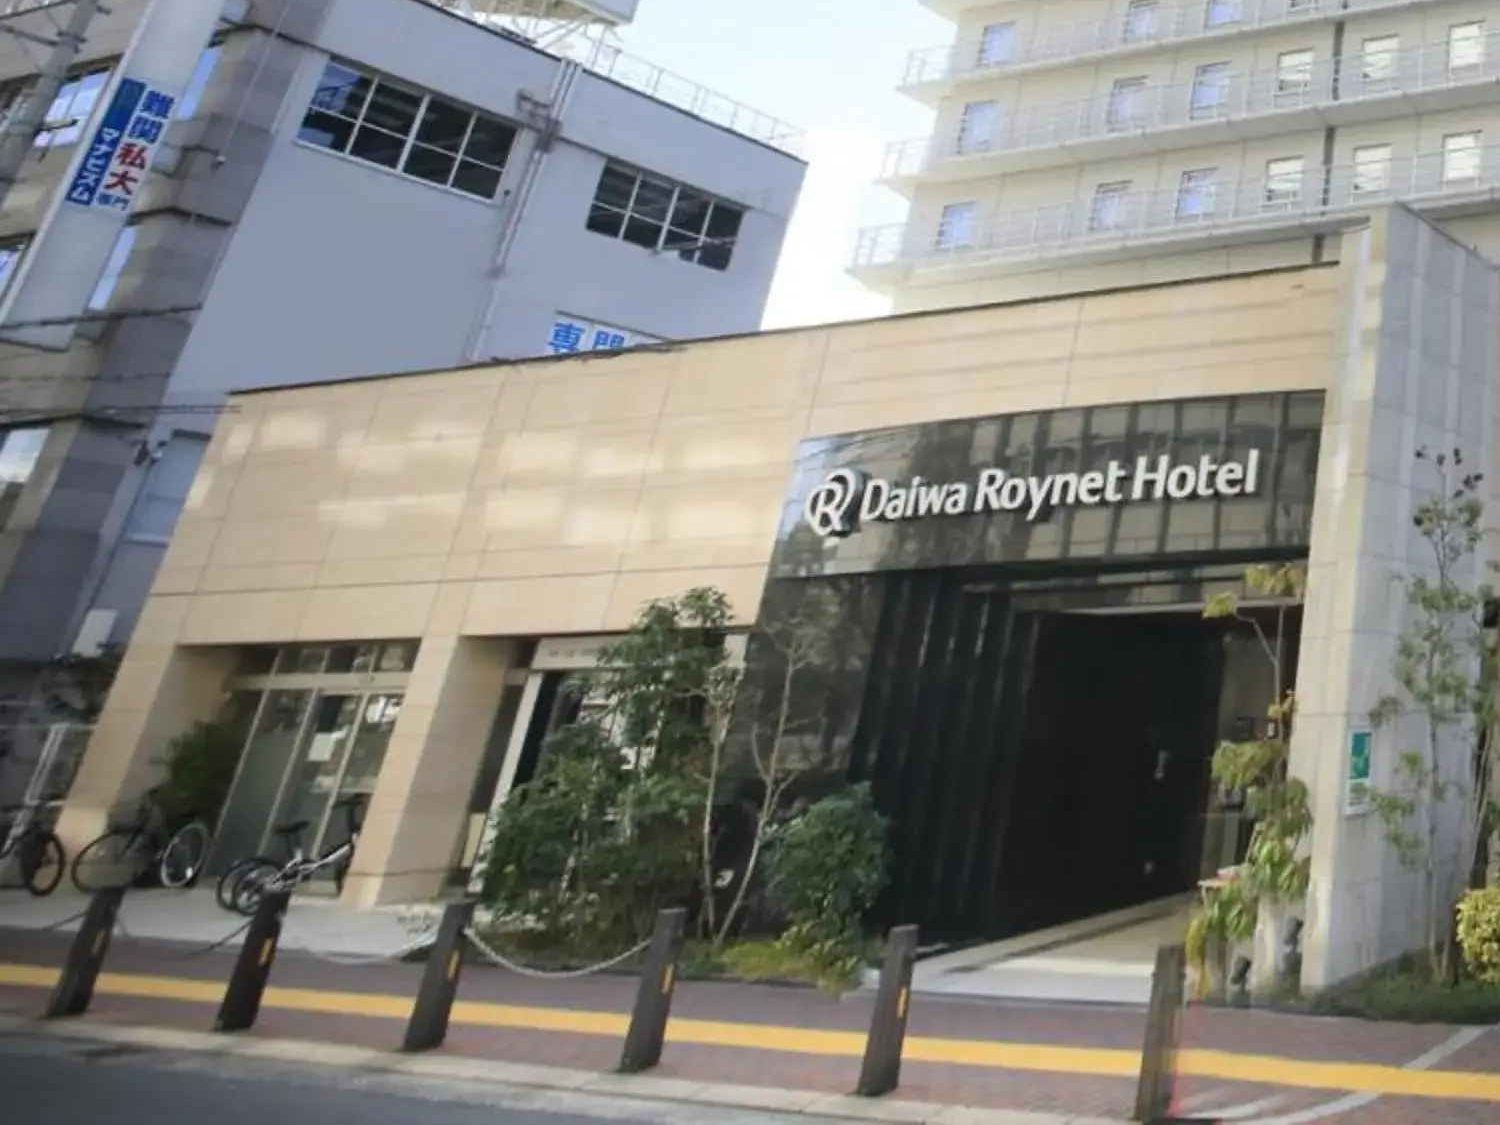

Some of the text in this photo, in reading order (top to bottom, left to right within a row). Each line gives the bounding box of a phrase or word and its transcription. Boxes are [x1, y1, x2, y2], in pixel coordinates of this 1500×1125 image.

[860, 476, 965, 522] Daiwa
[973, 460, 1127, 521] Roynet
[1131, 448, 1260, 500] Hotel
